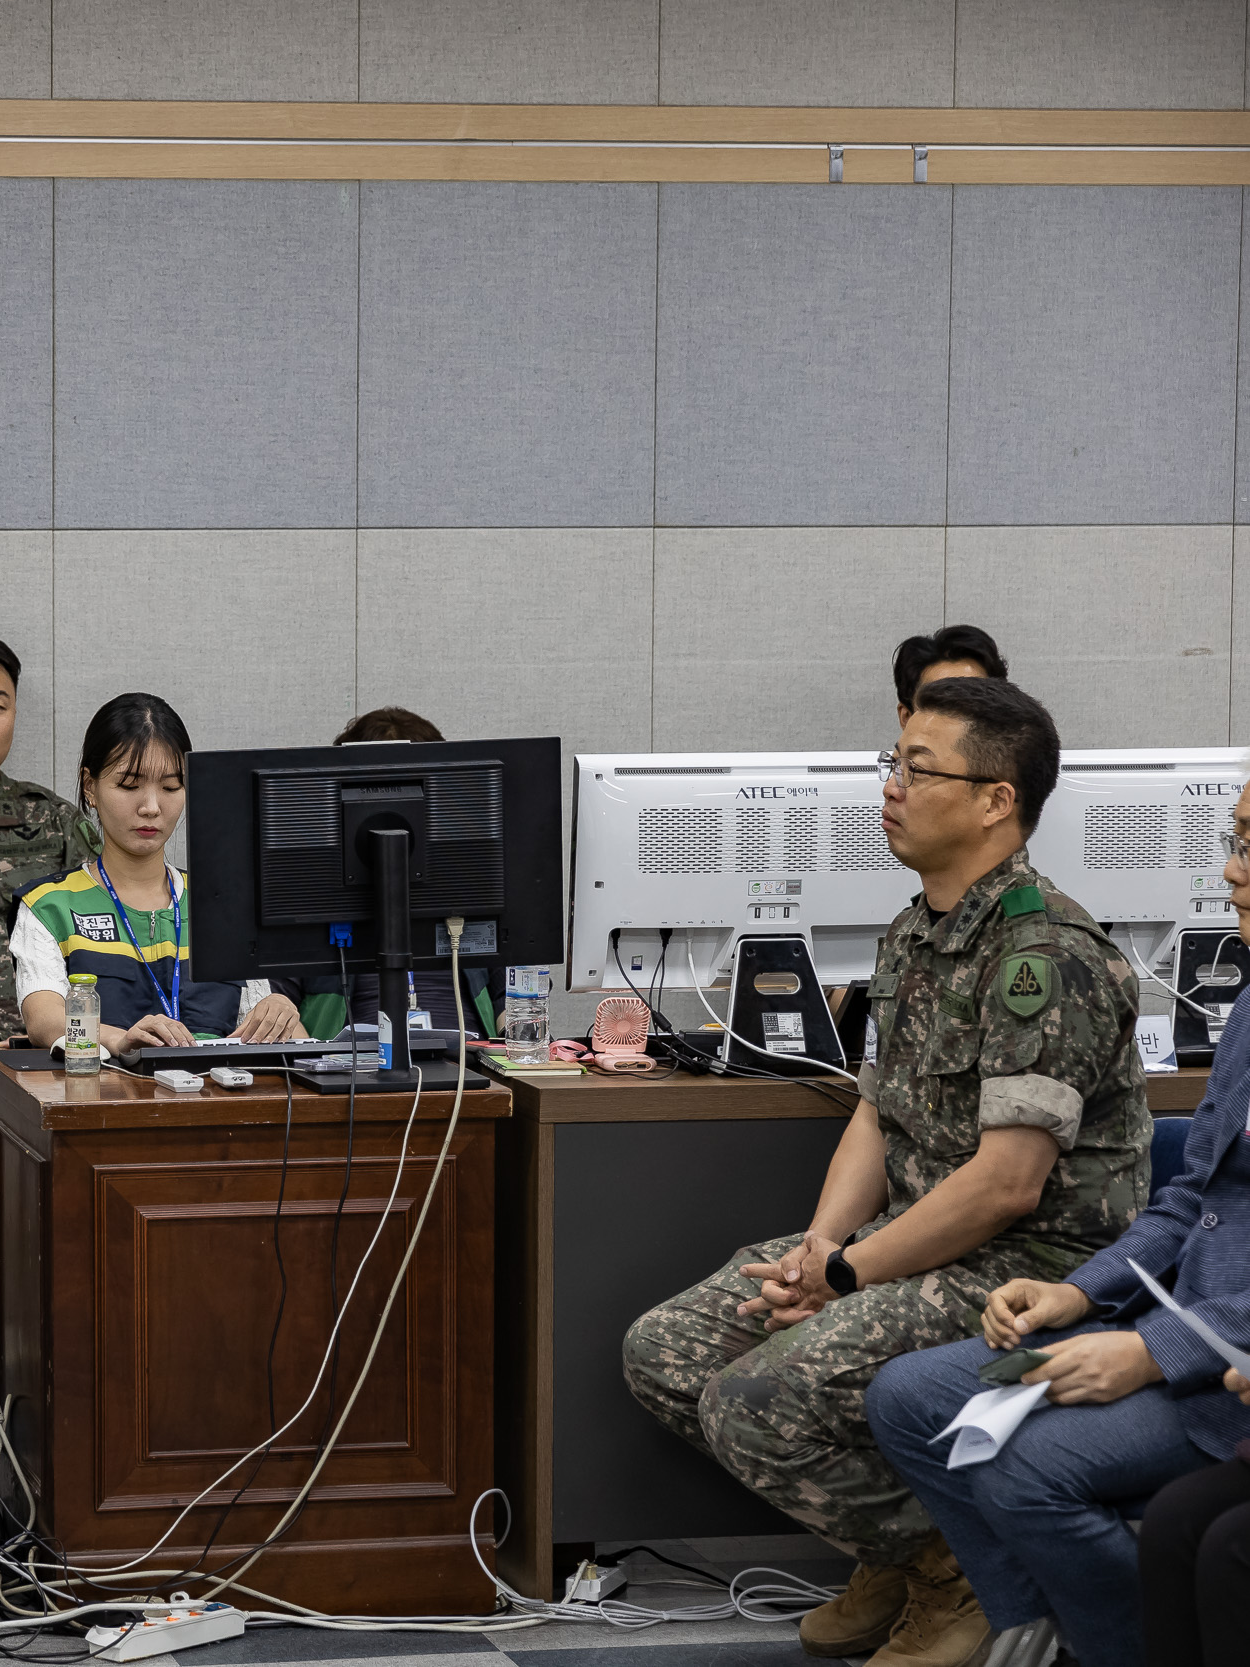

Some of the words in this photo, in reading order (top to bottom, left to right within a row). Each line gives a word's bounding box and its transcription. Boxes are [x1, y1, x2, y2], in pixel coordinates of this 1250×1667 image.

[735, 786, 785, 799] ATEC
[786, 787, 819, 797] 에이텍
[1180, 783, 1230, 796] ATEC
[1013, 973, 1037, 992] 56
